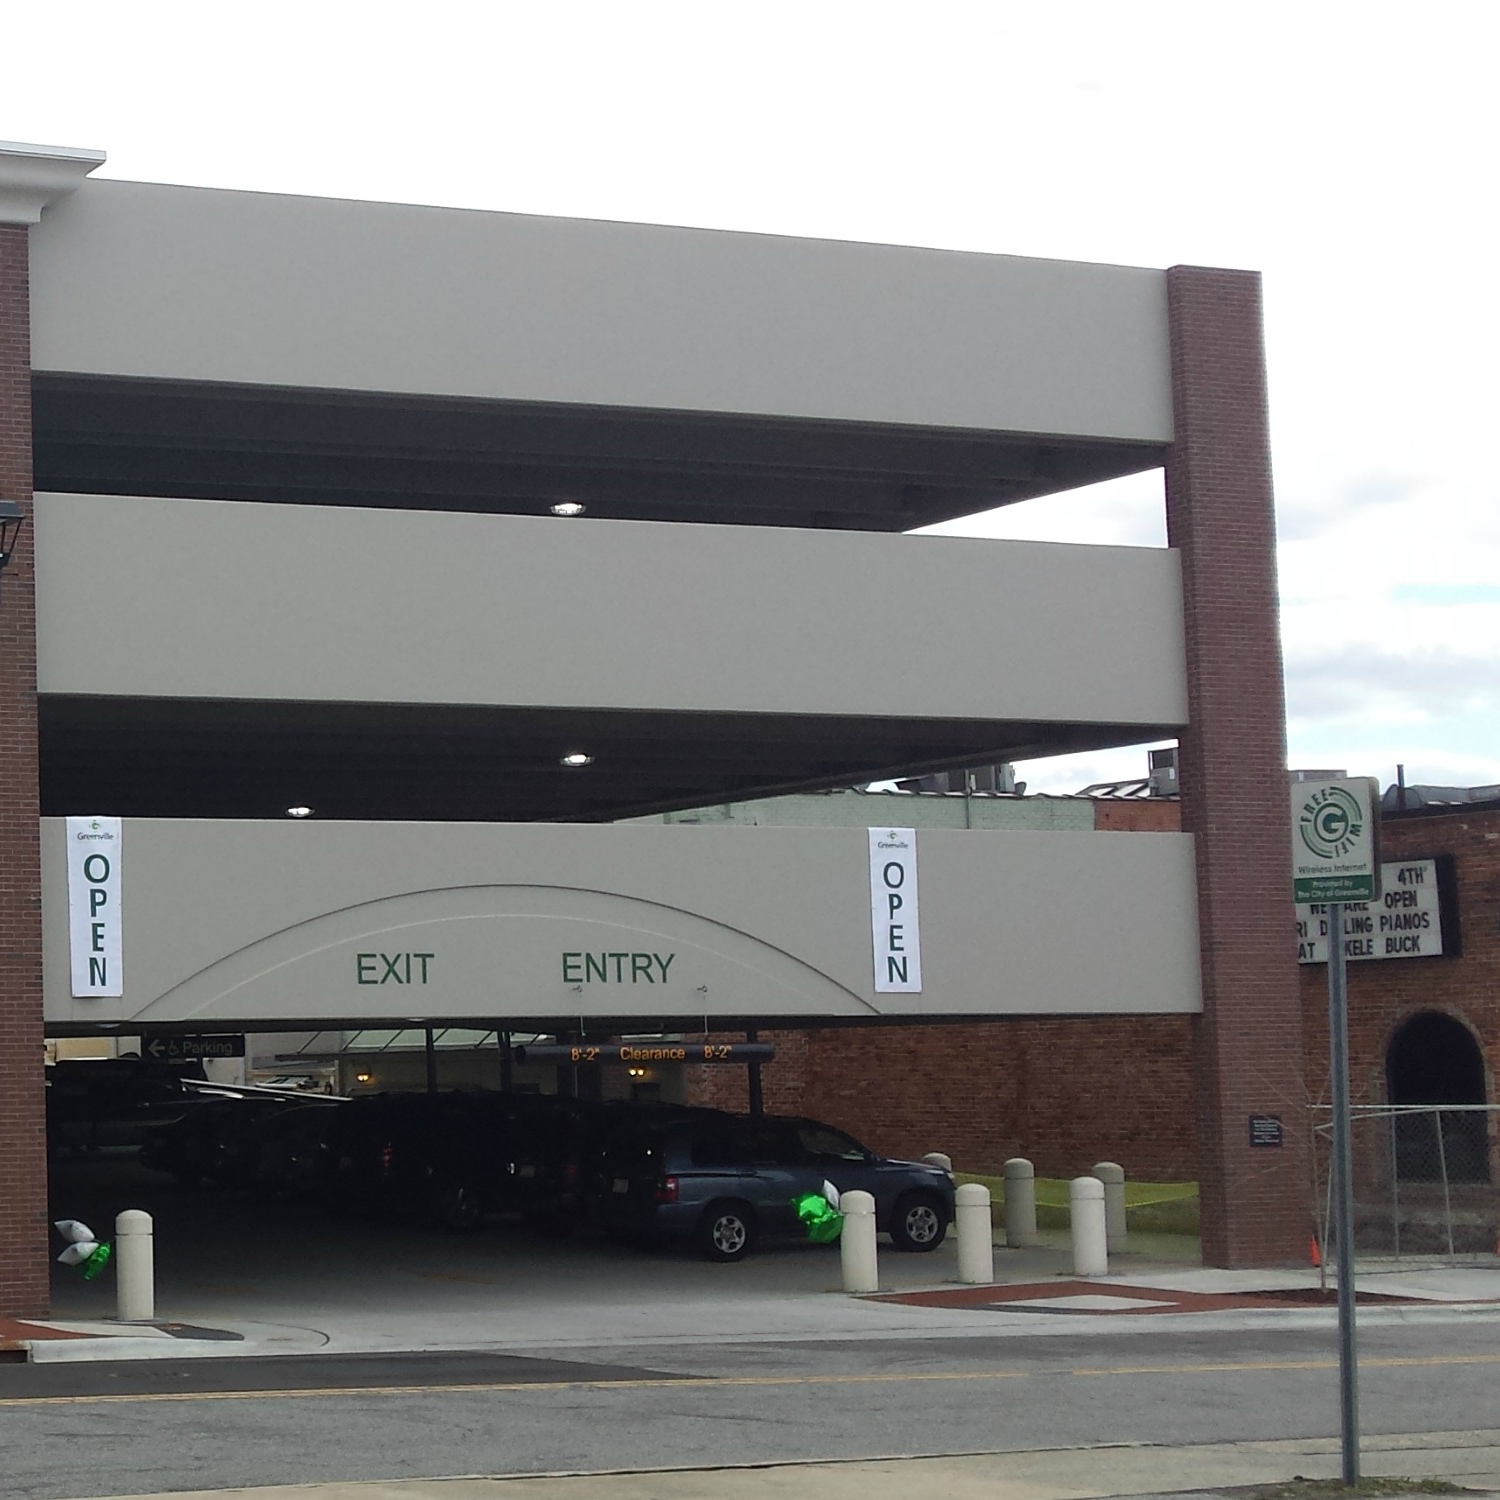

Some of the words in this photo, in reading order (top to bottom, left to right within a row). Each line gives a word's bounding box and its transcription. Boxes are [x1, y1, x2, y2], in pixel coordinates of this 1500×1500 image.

[1301, 788, 1329, 823] FREE
[76, 831, 114, 841] Greenville
[877, 841, 909, 849] Greenville
[1333, 823, 1362, 858] WIFI
[1298, 865, 1333, 874] Wireless
[1334, 863, 1367, 873] Internet
[1311, 889, 1325, 900] City
[1385, 890, 1418, 909] OPEN
[83, 853, 110, 987] OPEN
[883, 861, 908, 984] OPEN
[1380, 912, 1430, 932] PIANOS
[1385, 935, 1420, 954] BUCK
[356, 953, 435, 985] EXIT
[562, 952, 676, 984] ENTRY
[182, 1040, 233, 1056] Parking
[620, 1046, 686, 1061] Clearance
